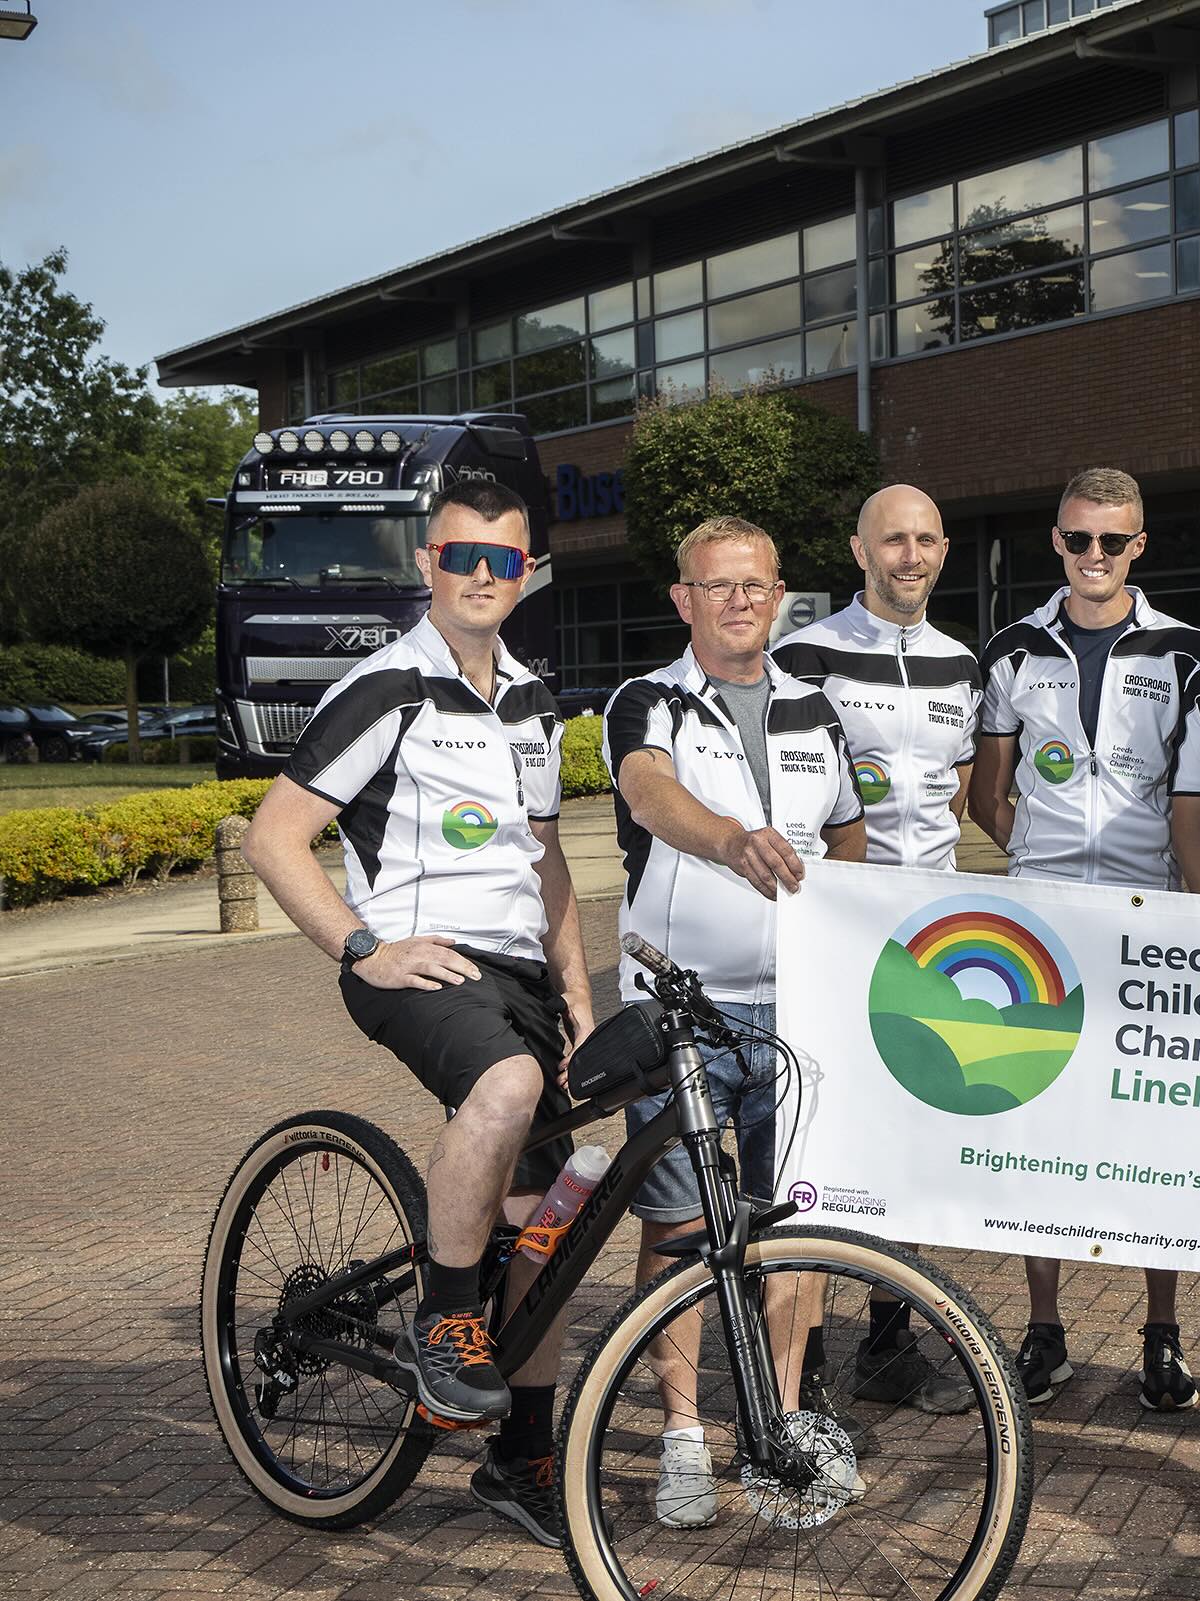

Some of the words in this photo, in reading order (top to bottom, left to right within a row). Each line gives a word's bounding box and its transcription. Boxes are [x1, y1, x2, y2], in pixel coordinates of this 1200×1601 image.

[333, 470, 384, 485] 780
[1028, 682, 1075, 690] VOLVO
[1125, 674, 1171, 693] CROSSROADS
[1123, 686, 1142, 697] TRUCK
[1149, 691, 1161, 702] BUS
[840, 700, 895, 711] VOLVO
[928, 700, 964, 717] CROSSROADS
[928, 713, 945, 725] TRUCK
[432, 740, 486, 749] VOLVO
[1113, 745, 1133, 754] Leeds
[696, 745, 744, 761] VLVO
[780, 750, 825, 764] CROSSROADS
[1111, 752, 1145, 765] Children's
[780, 763, 800, 773] TRUCK
[807, 764, 818, 774] BUS
[1109, 760, 1135, 771] Charity
[1136, 773, 1154, 782] Farm
[289, 1130, 318, 1142] vittoria
[320, 1131, 366, 1161] TERRENO
[959, 1147, 1089, 1181] Brightening
[793, 1190, 812, 1204] FR
[823, 1186, 855, 1194] Registered
[822, 1193, 887, 1208] FUNDRAISING
[821, 1202, 886, 1217] REGULATOR
[273, 1369, 295, 1388] NX
[945, 1306, 982, 1355] vittoria
[979, 1358, 1011, 1455] TERRENO
